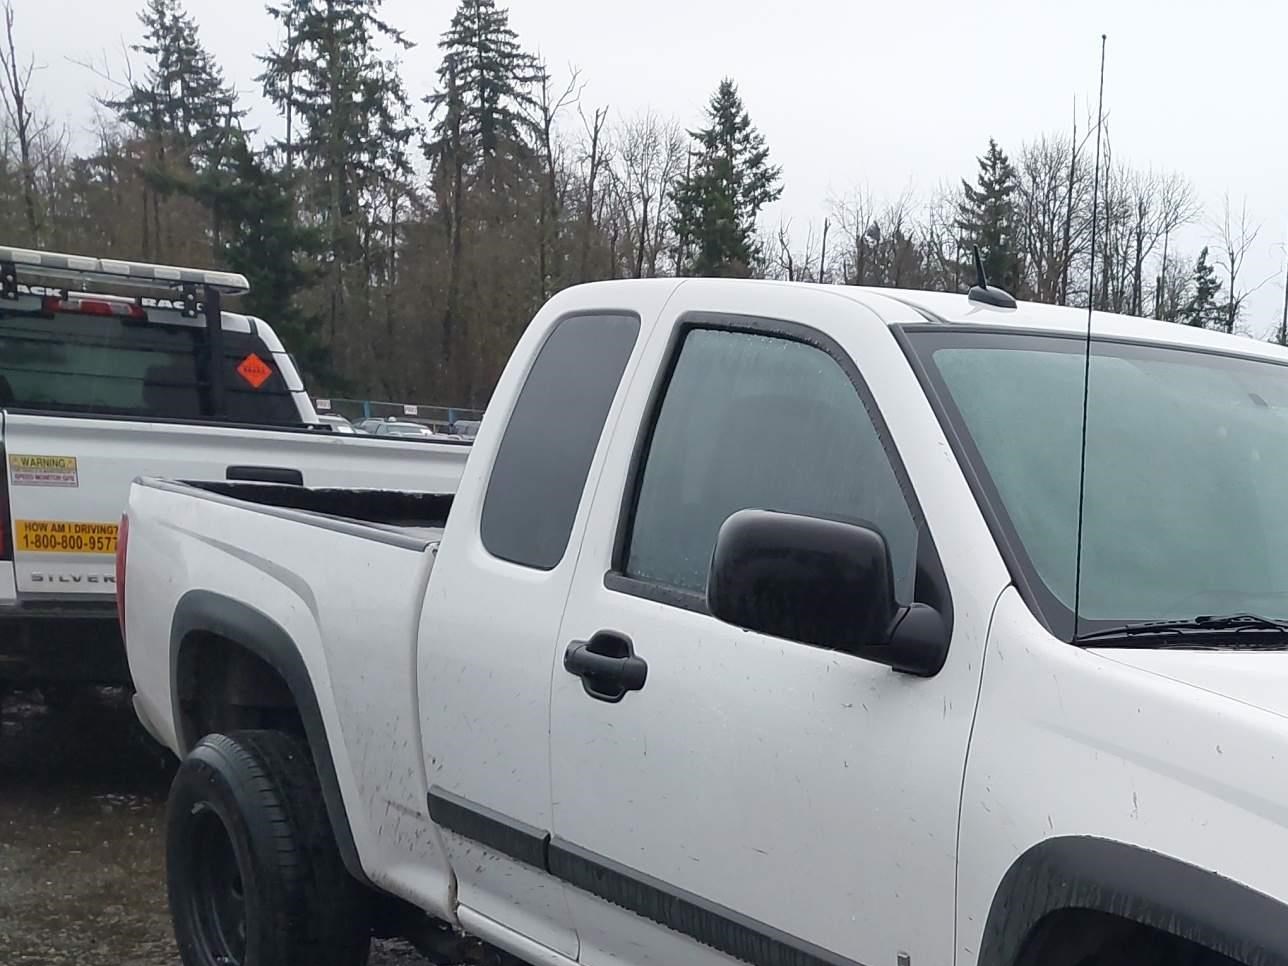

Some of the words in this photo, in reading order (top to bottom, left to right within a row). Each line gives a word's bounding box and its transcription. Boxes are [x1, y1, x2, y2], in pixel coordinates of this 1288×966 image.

[17, 284, 62, 297] ACK
[20, 457, 65, 467] WARNING
[25, 522, 48, 533] HOW
[51, 524, 65, 534] AM
[75, 525, 118, 536] DRIVING?
[24, 534, 118, 551] 1-800-800-9577
